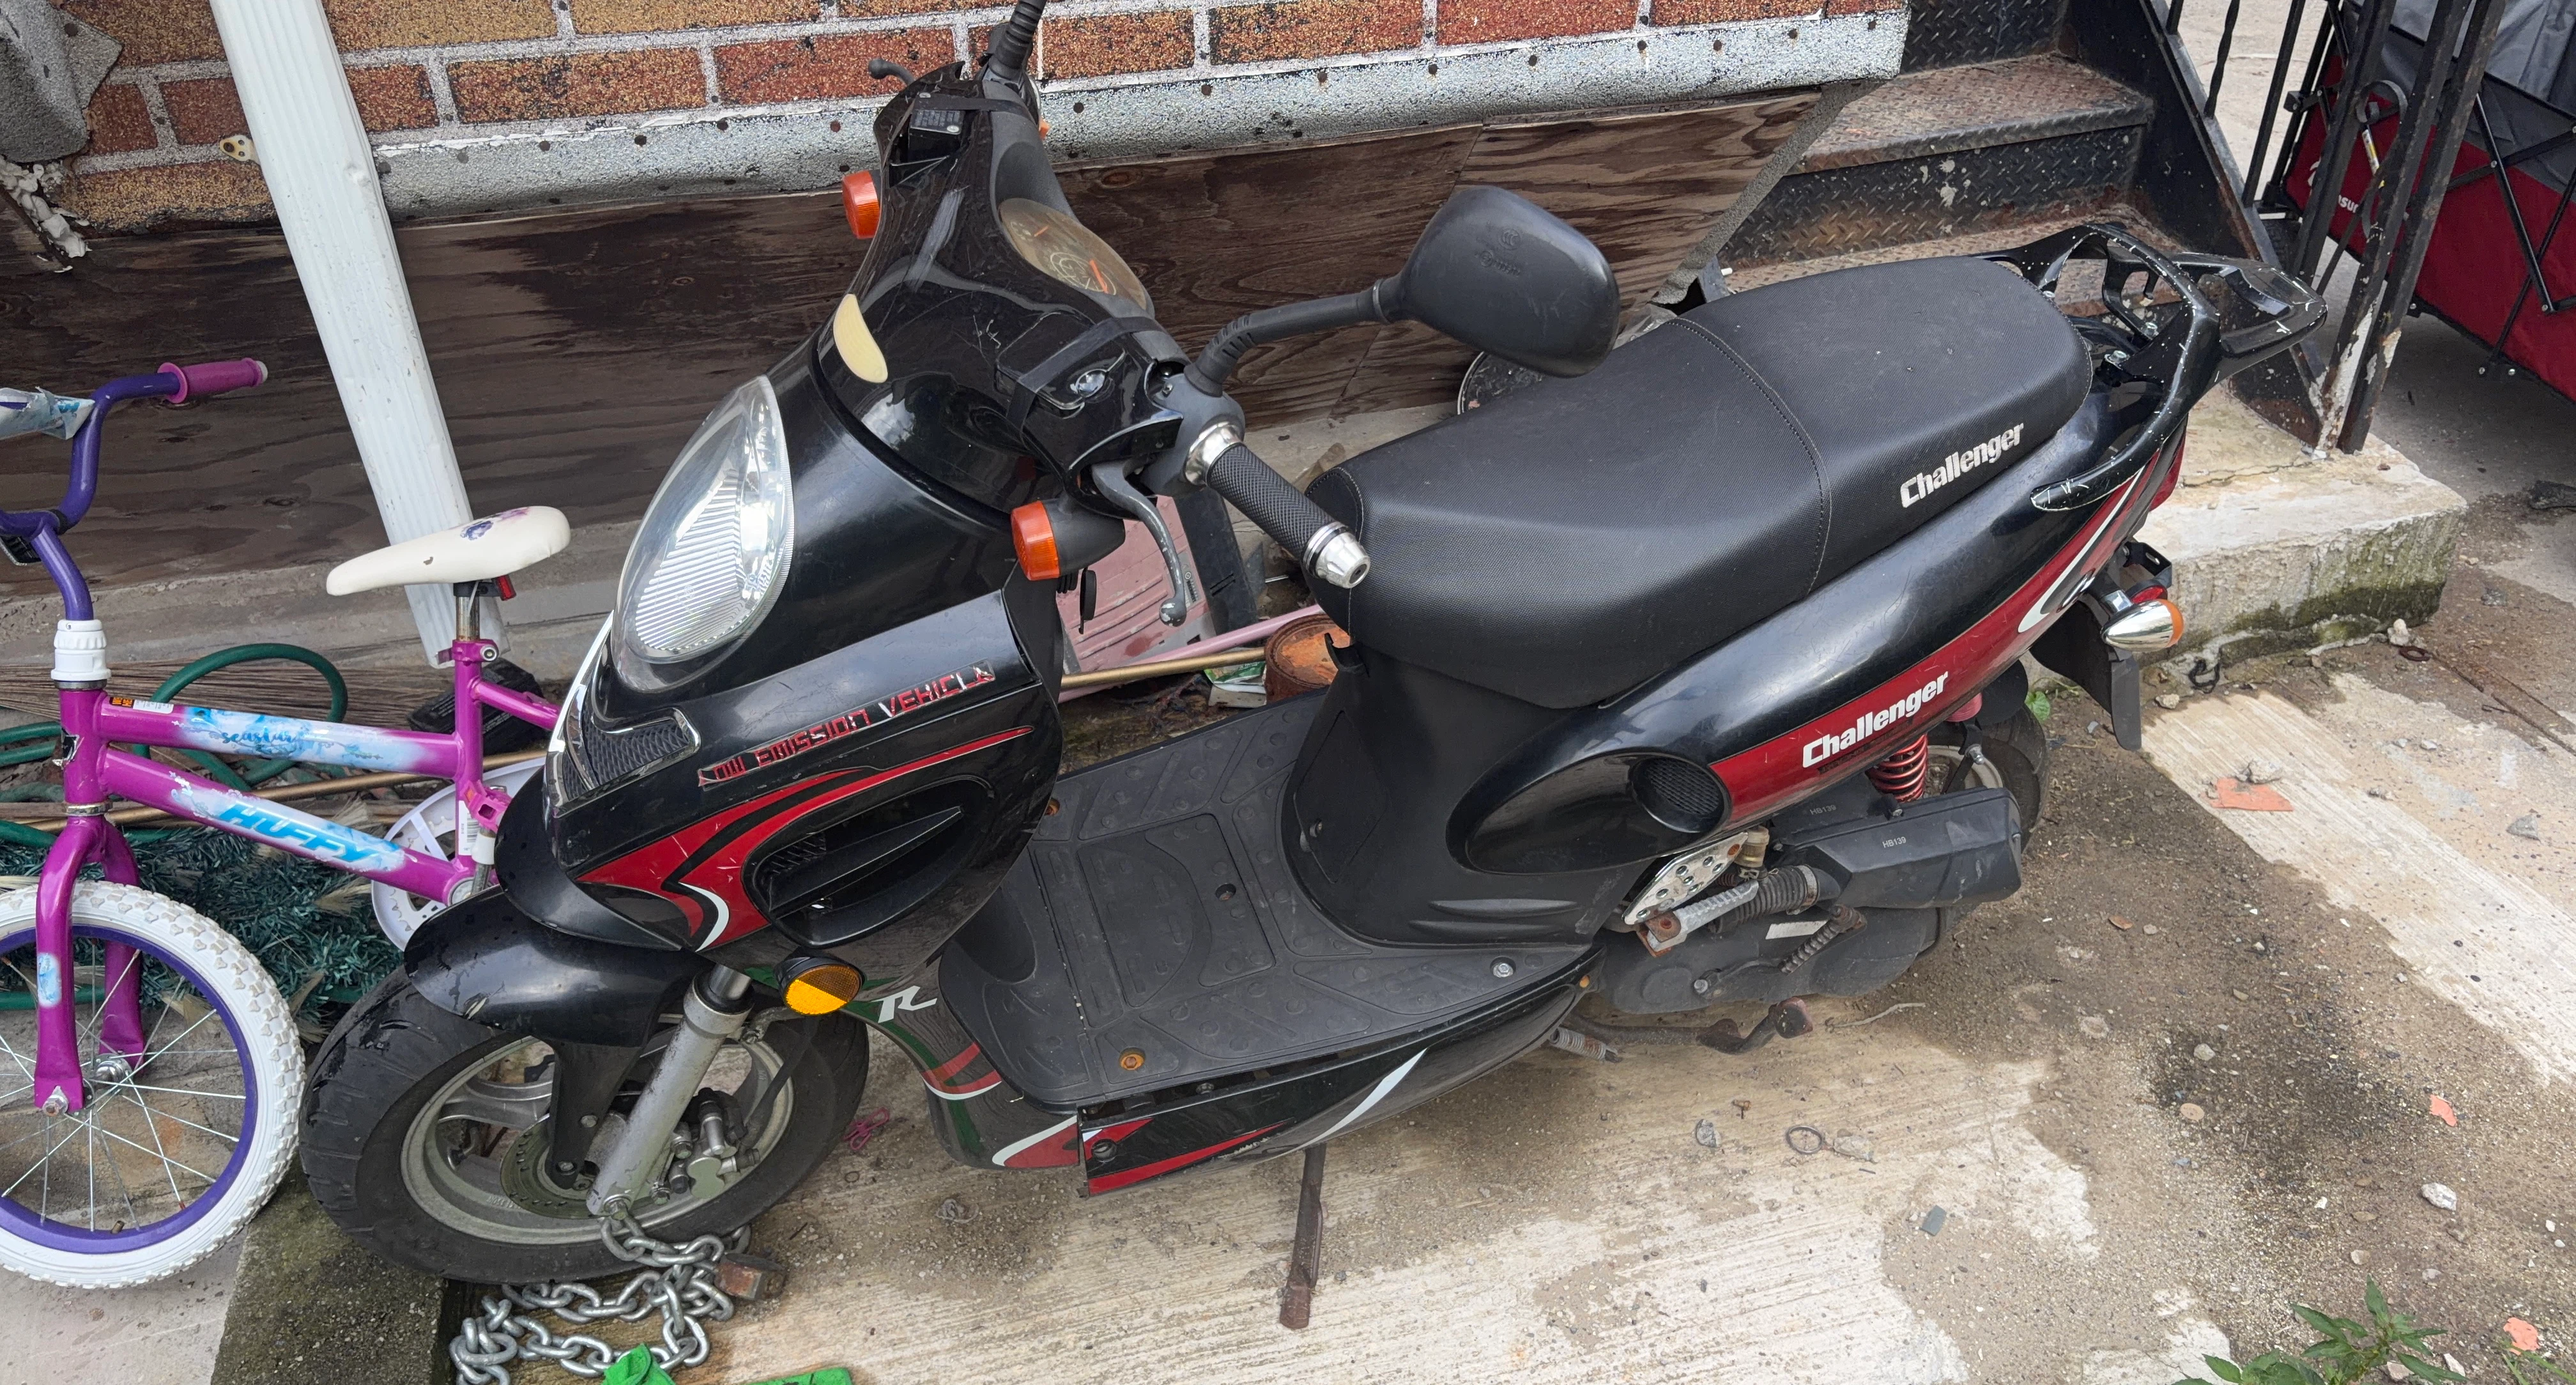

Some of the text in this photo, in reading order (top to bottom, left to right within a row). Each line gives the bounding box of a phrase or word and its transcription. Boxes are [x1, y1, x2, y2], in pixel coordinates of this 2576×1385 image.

[1900, 423, 2024, 509] Challenger
[753, 708, 871, 767] EMISSION
[1802, 671, 1949, 769] Challenger
[218, 801, 378, 862] HUFFY
[1809, 804, 1837, 815] HB139
[1882, 836, 1906, 848] HB139
